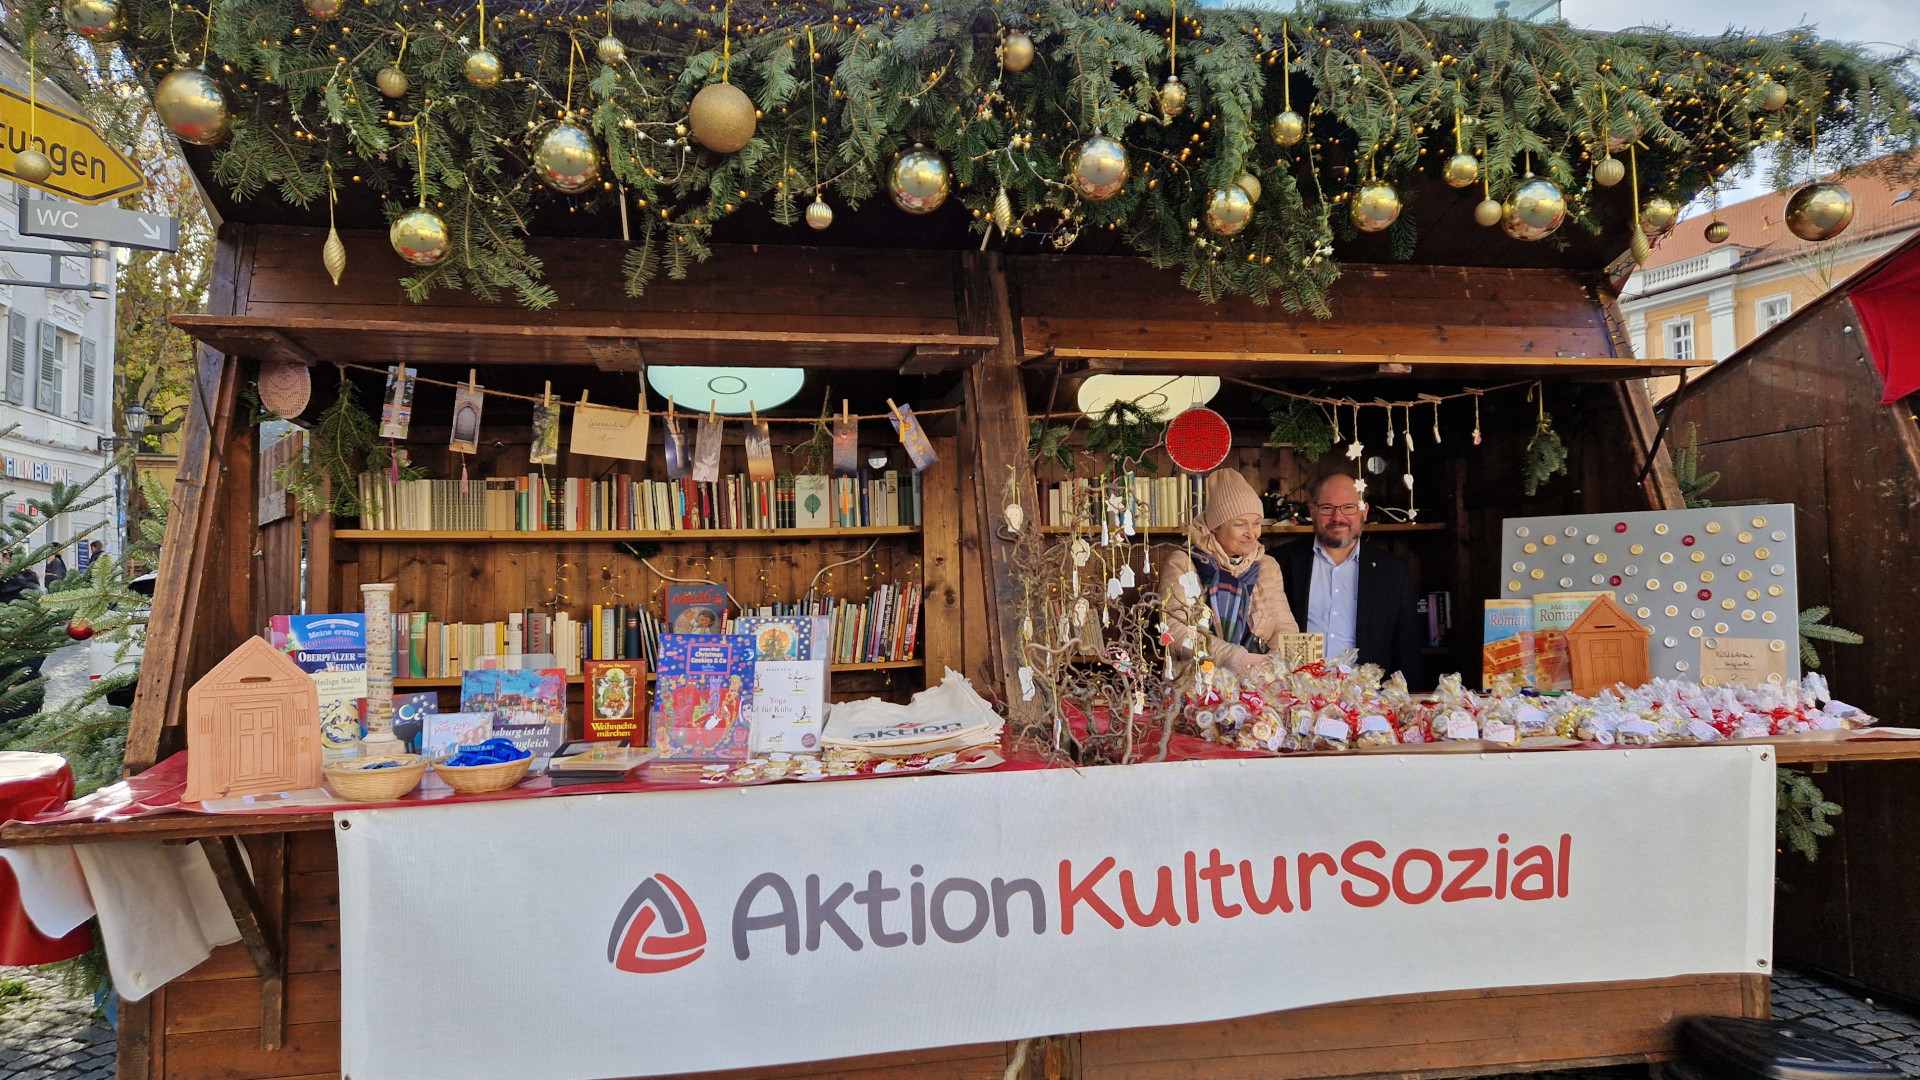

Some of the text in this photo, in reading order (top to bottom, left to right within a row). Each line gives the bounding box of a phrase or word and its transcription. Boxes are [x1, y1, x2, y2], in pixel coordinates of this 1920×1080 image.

[37, 208, 79, 229] WC
[6, 457, 74, 487] FILMBÜHNE
[1491, 614, 1529, 626] Roman
[1540, 609, 1581, 622] Roman
[308, 629, 359, 640] Meine ersten
[298, 651, 355, 662] OBERPFÄLZER
[315, 676, 361, 686] Heilige Nacht
[769, 697, 786, 705] Yoga
[523, 727, 535, 736] ist
[537, 725, 550, 735] alt
[591, 722, 637, 731] Weihnachts
[596, 730, 631, 738] märchen
[732, 833, 1572, 961] AktionKulturSozial
